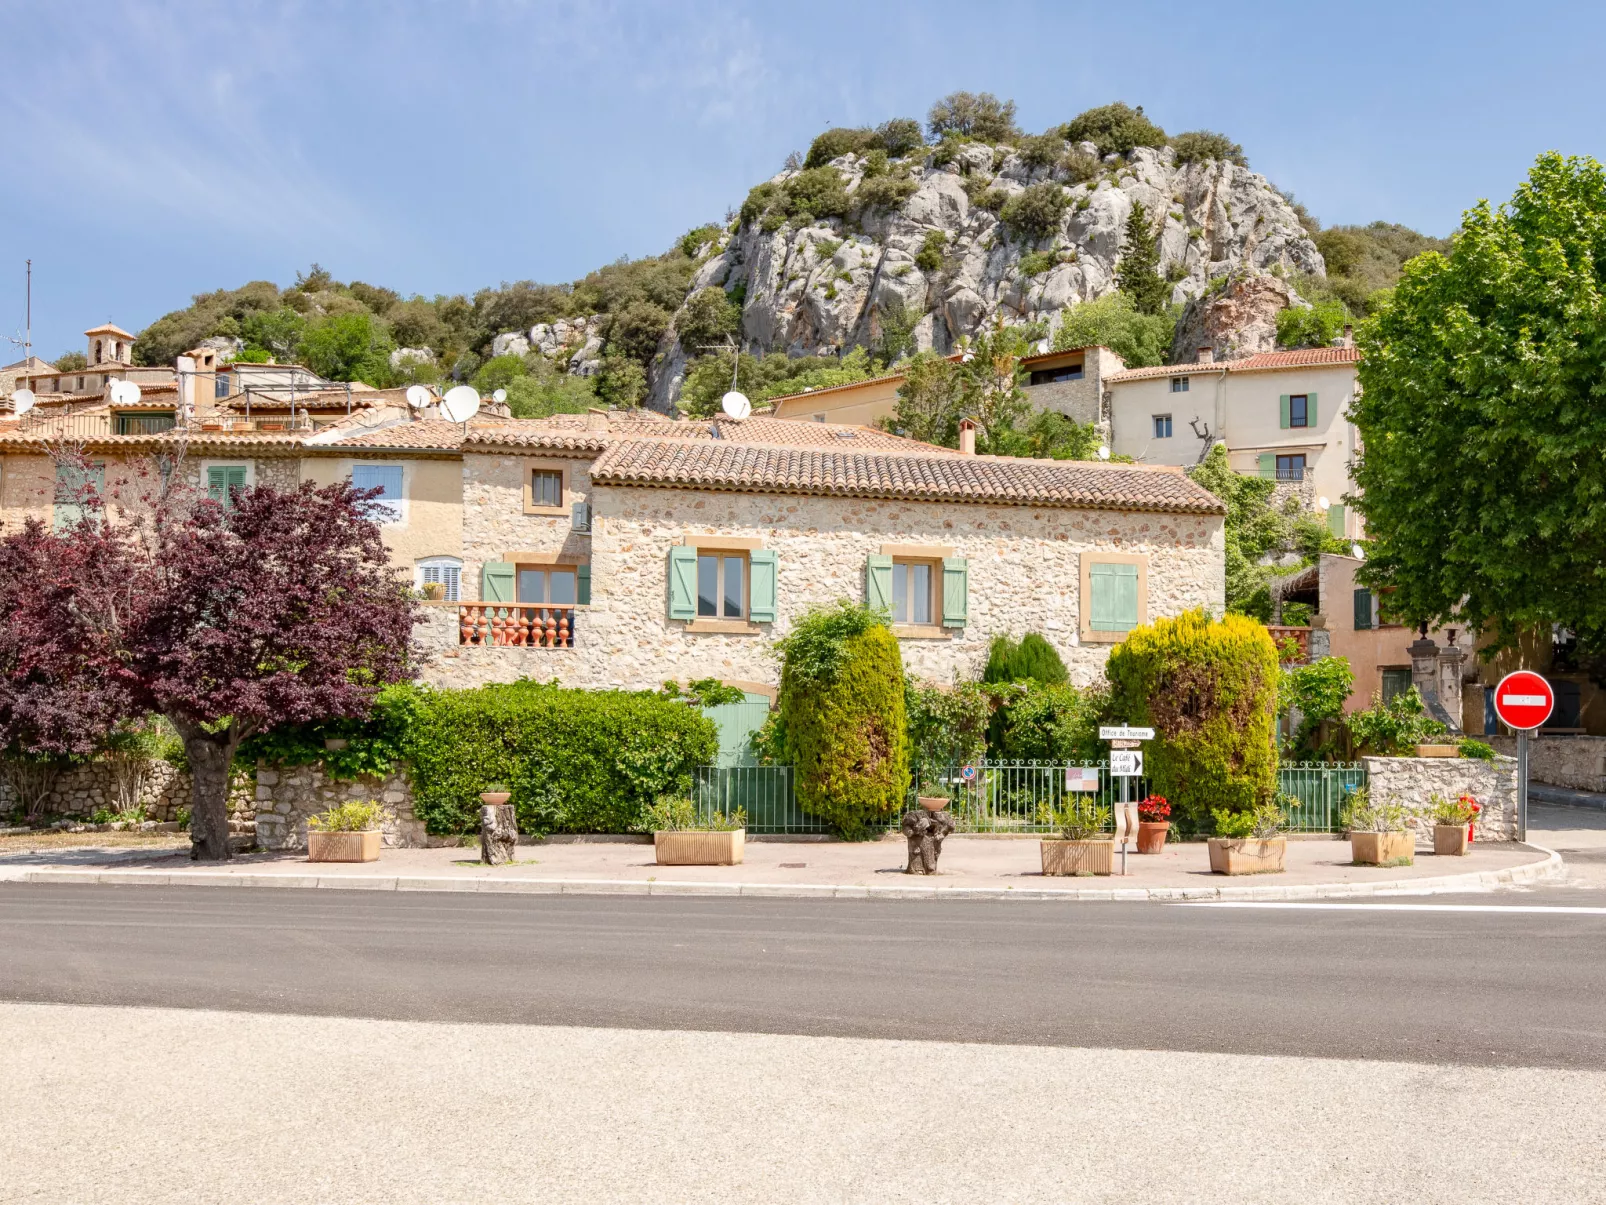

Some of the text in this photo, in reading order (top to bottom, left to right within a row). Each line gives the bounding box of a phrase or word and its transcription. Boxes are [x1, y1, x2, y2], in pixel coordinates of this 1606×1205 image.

[1101, 729, 1148, 737] Office de Tourisme
[1112, 753, 1131, 762] Le Café
[1112, 764, 1118, 773] du
